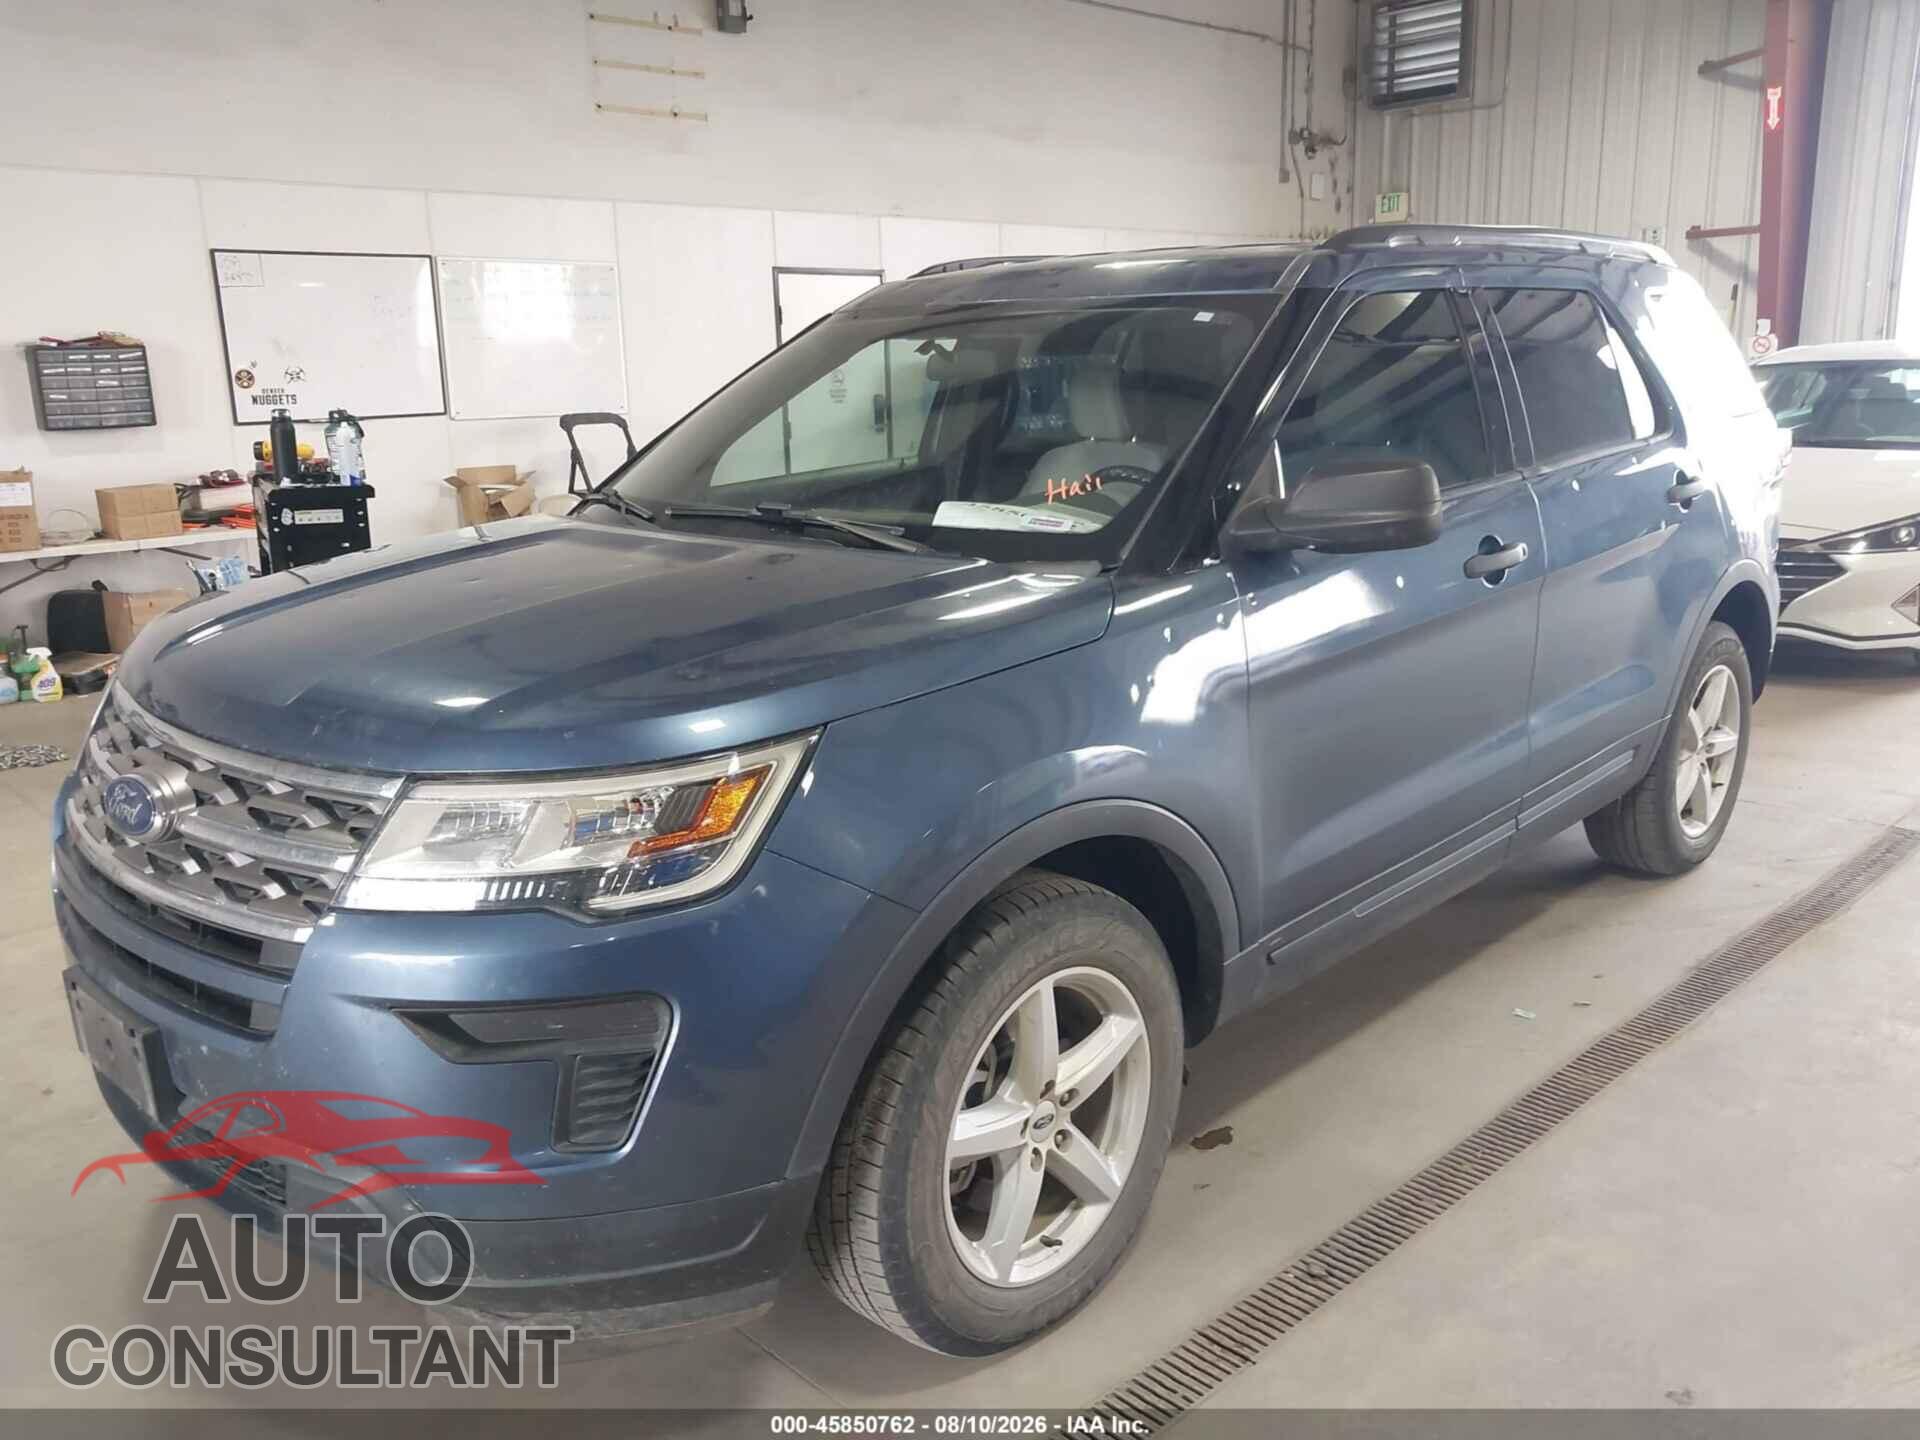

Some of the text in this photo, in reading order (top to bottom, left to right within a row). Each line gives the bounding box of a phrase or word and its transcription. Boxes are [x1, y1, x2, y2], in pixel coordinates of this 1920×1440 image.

[1380, 193, 1401, 214] EXIT
[251, 394, 297, 406] NUGGETS
[1044, 473, 1104, 505] Hail
[108, 783, 143, 825] Ford
